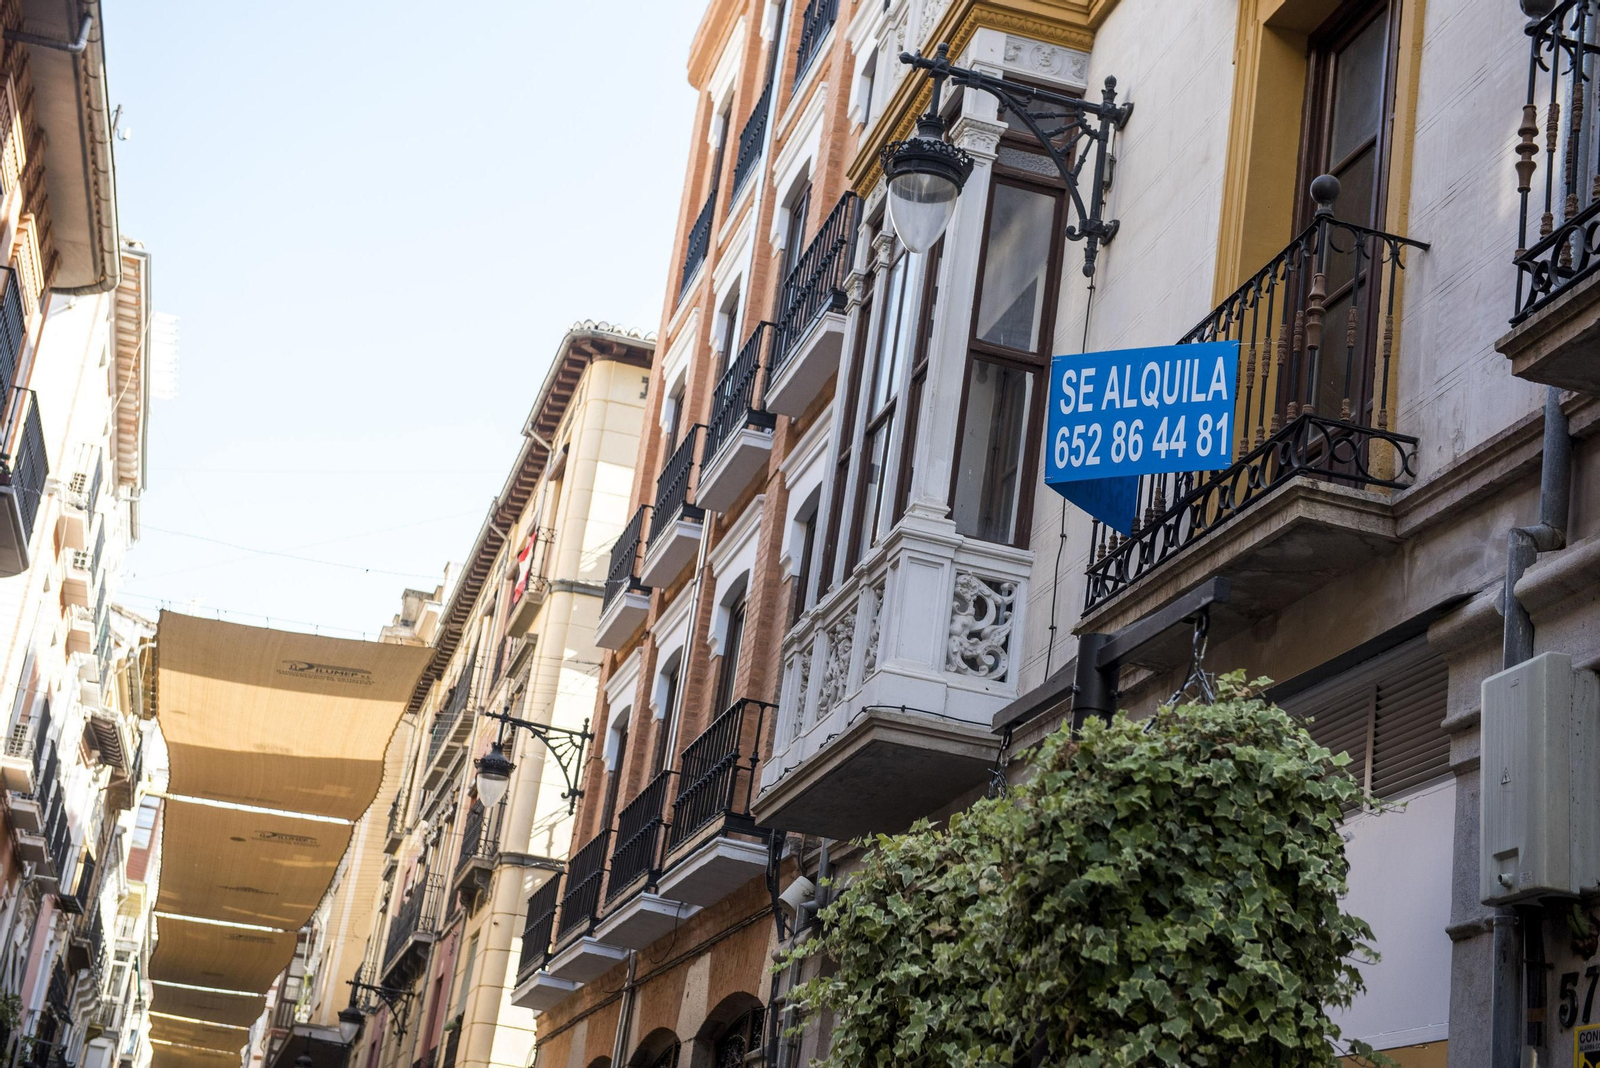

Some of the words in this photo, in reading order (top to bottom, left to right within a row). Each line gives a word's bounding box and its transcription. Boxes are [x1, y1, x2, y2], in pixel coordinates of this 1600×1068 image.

[1060, 367, 1096, 415] SE
[1101, 356, 1228, 410] ALQUILA
[1054, 422, 1103, 470] 652
[1111, 418, 1144, 464] 86
[1152, 415, 1187, 459] 44
[1196, 412, 1229, 457] 81
[1559, 965, 1600, 1029] 57
[1580, 1030, 1600, 1044] CON
